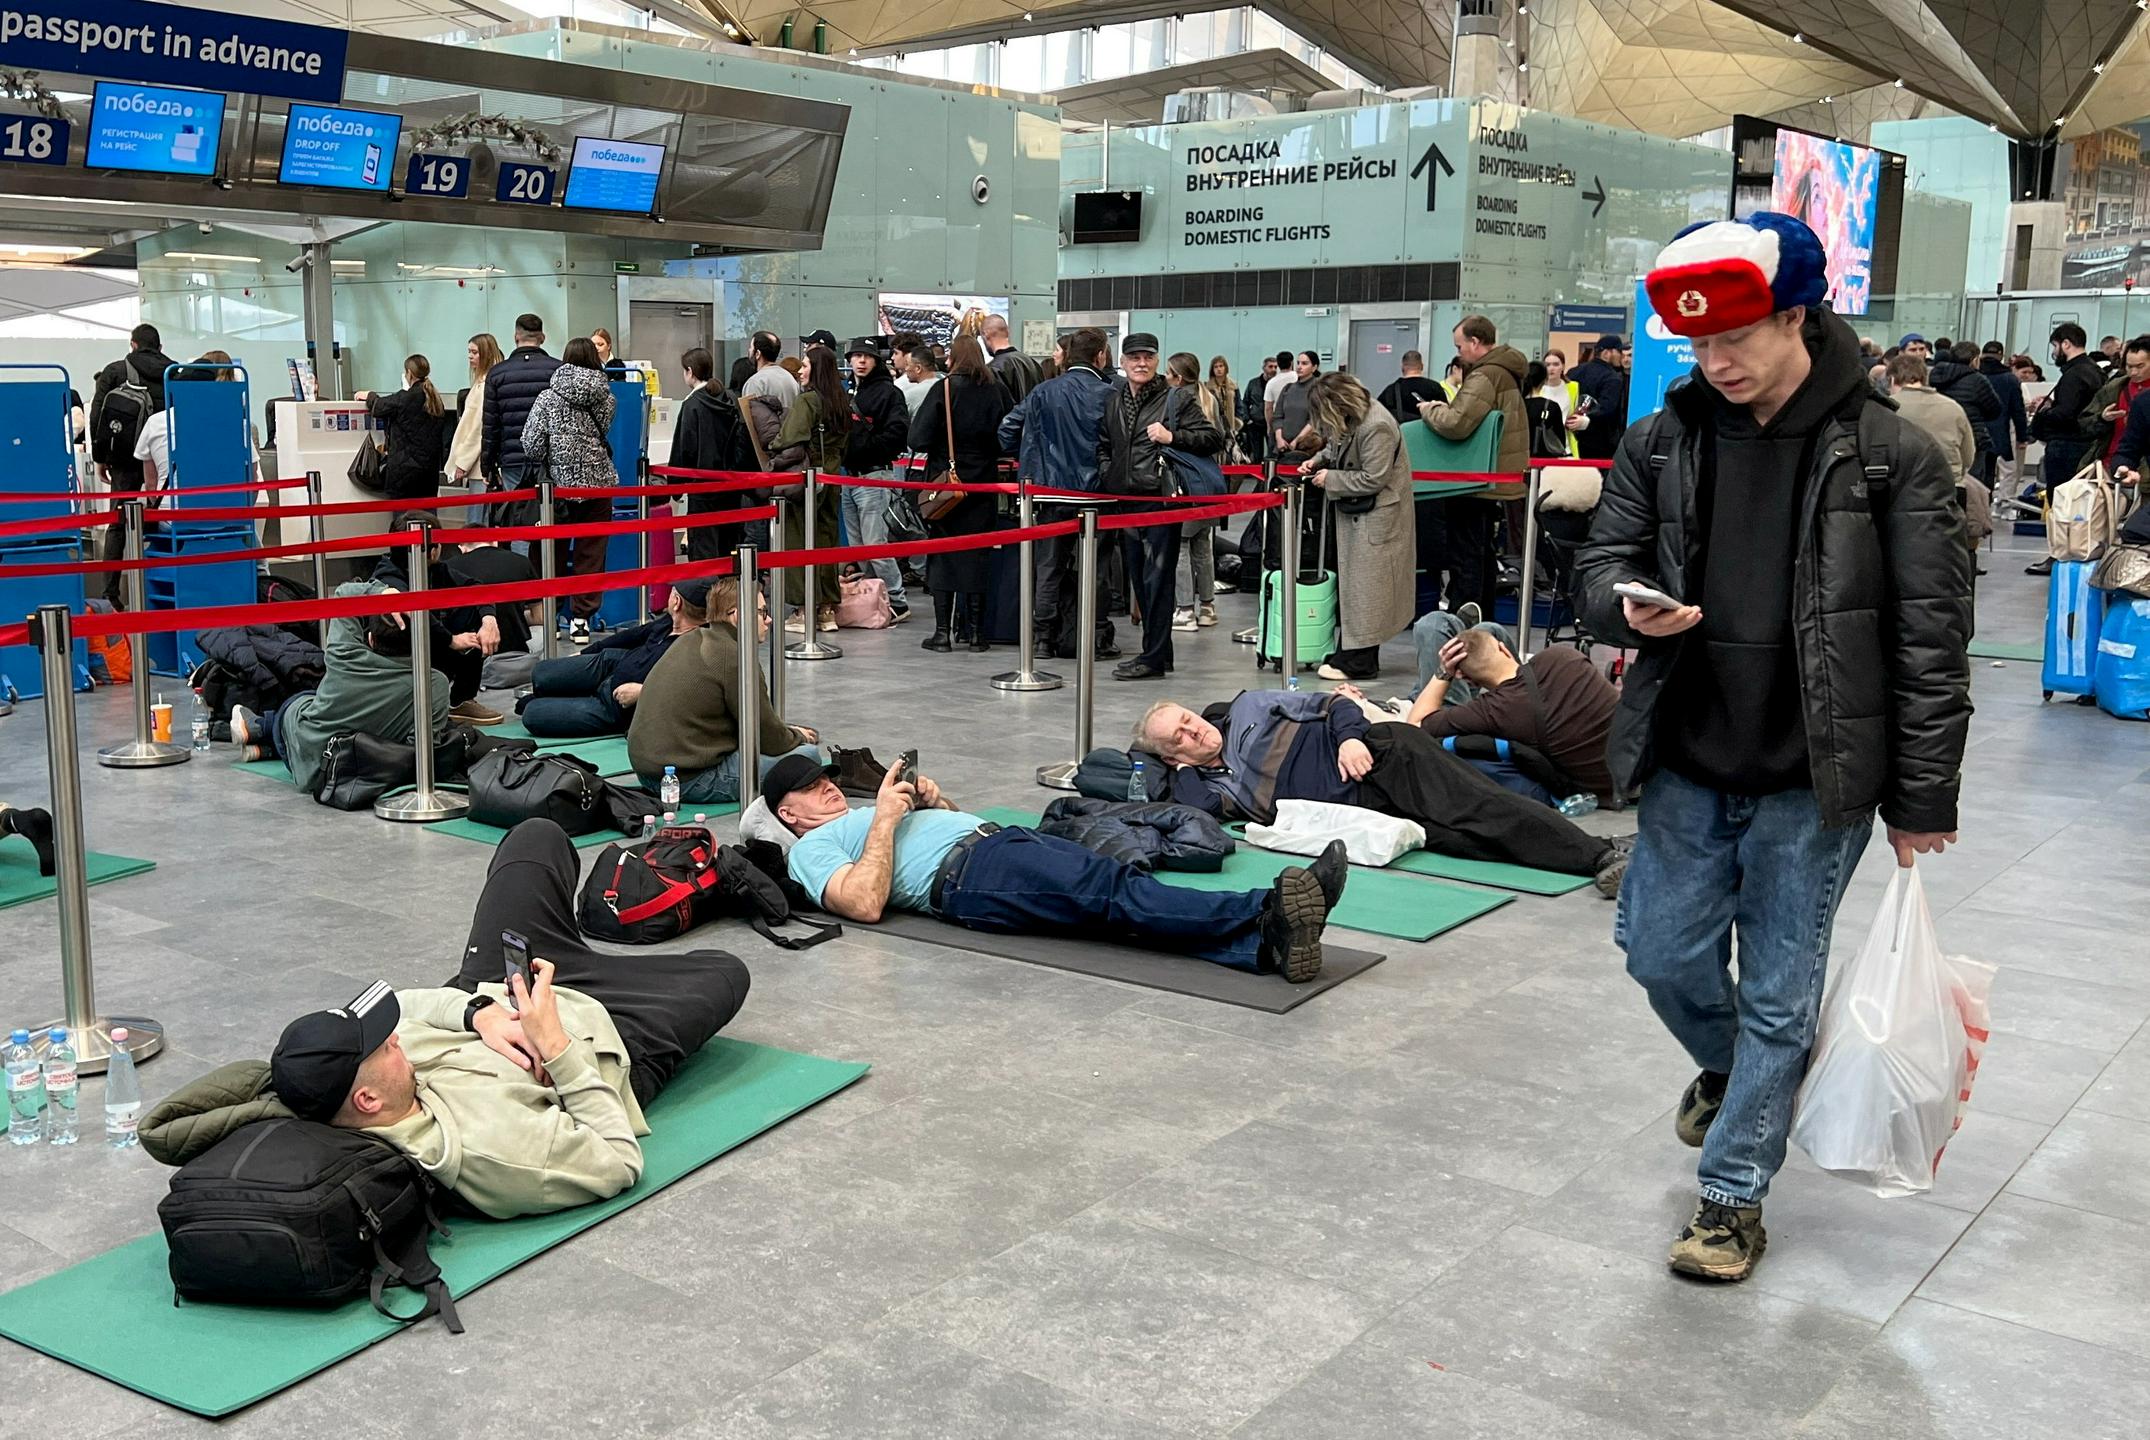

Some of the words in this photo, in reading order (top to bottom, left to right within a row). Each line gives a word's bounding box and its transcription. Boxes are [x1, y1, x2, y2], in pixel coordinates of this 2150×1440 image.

[1, 10, 155, 52] passport
[163, 26, 191, 58] in
[199, 35, 322, 75] advance
[105, 93, 182, 117] победа
[102, 128, 164, 141] РЕГИСТРАЦИЯ
[297, 114, 364, 136] победа
[4, 120, 52, 159] 18
[100, 141, 113, 149] НА
[115, 142, 138, 151] РЕЙС
[295, 139, 321, 150] DROP
[322, 142, 341, 152] OFF
[1480, 126, 1528, 154] ПОСАДКА
[591, 149, 630, 162] победа
[1187, 141, 1281, 166] ПОСАДКА
[420, 160, 458, 192] 19
[1186, 165, 1318, 192] ВНУТРЕННИЕ
[1323, 156, 1397, 182] РЕЙСЫ
[1479, 155, 1544, 182] ВНУТРЕННИЕ
[509, 168, 545, 200] 20
[1185, 207, 1264, 225] BOARDING
[1477, 195, 1518, 214] BOARDING
[1184, 229, 1262, 246] DOMESTIC
[1265, 225, 1331, 242] FLIGHTS
[1476, 218, 1516, 237] DOMESTIC
[1517, 222, 1547, 240] FLIGHTS
